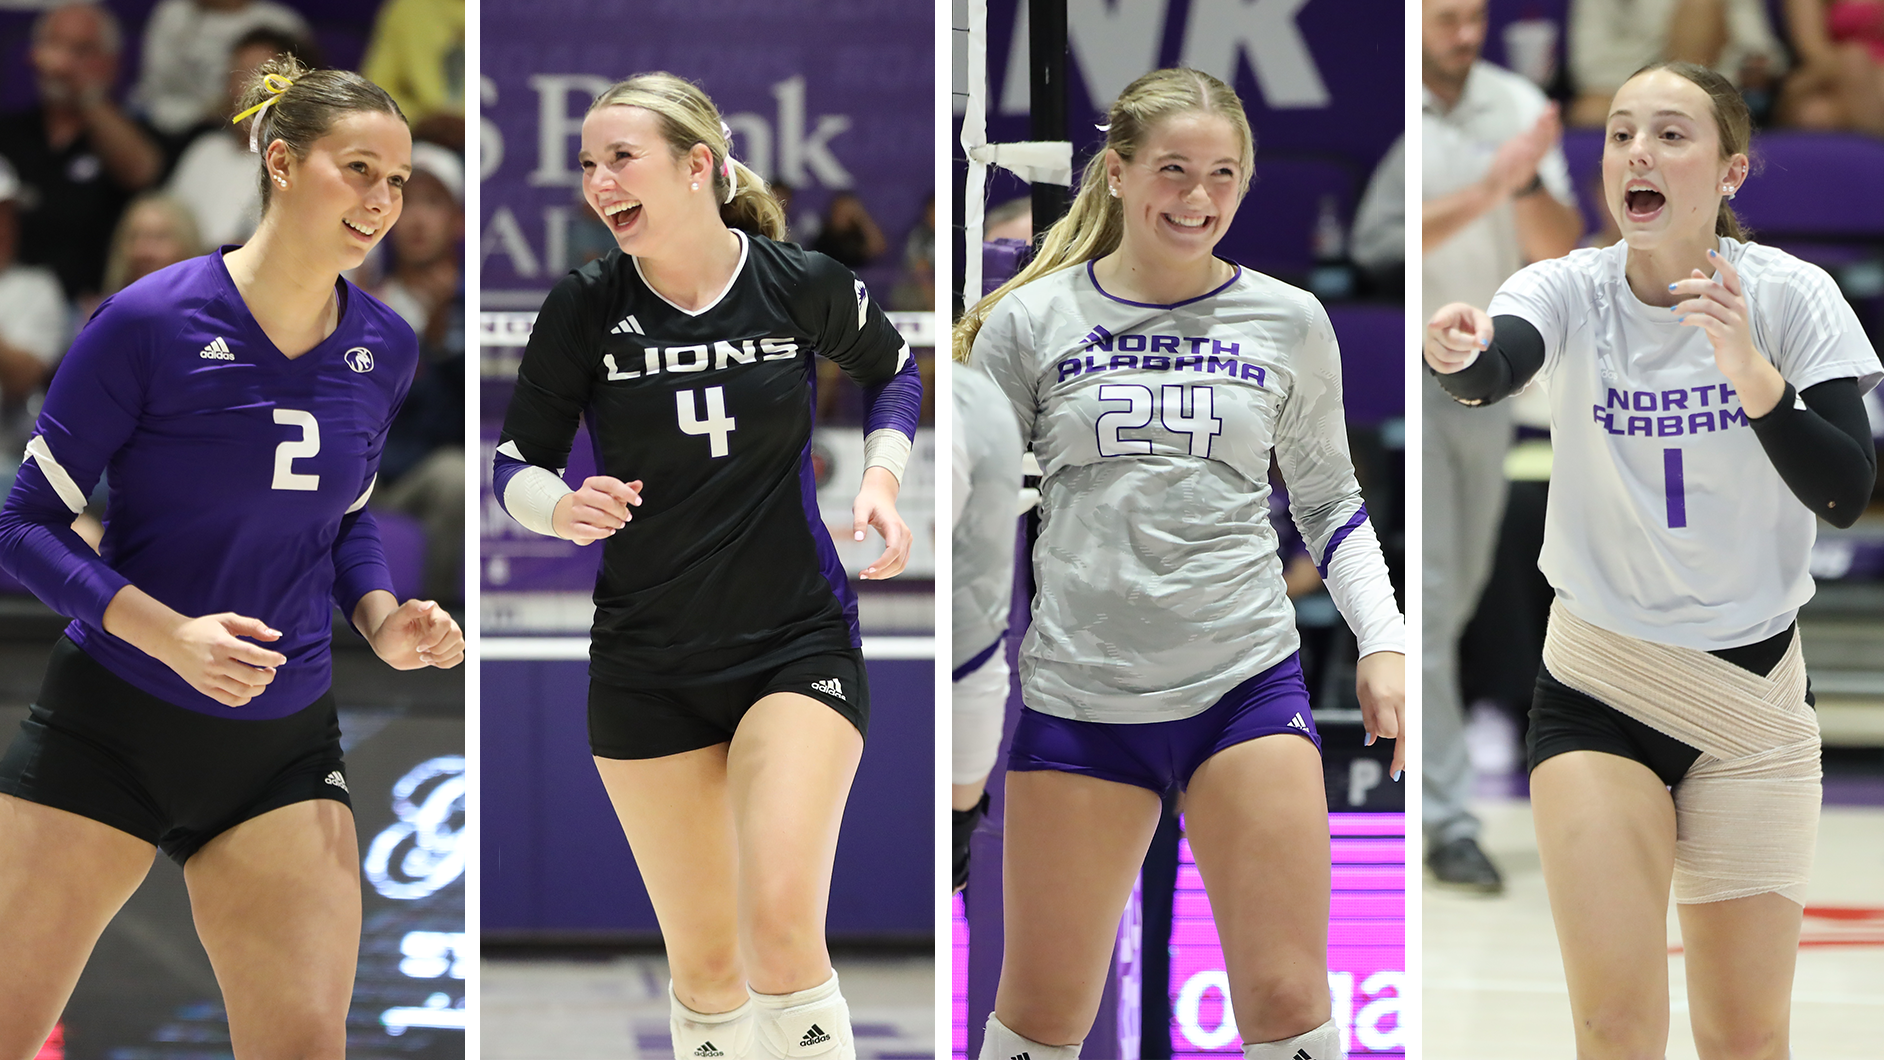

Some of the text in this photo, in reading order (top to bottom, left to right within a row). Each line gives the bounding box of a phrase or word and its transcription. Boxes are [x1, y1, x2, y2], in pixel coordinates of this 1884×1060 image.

[199, 349, 236, 361] adidas
[602, 336, 799, 382] LIONS
[1084, 333, 1240, 357] NORTH
[1057, 354, 1266, 388] ALABAMA
[674, 384, 737, 458] 4
[1095, 383, 1223, 460] 24
[1592, 405, 1750, 438] ALABAM
[271, 408, 321, 491] 2
[1663, 447, 1687, 529] 1
[799, 1033, 831, 1047] adidas
